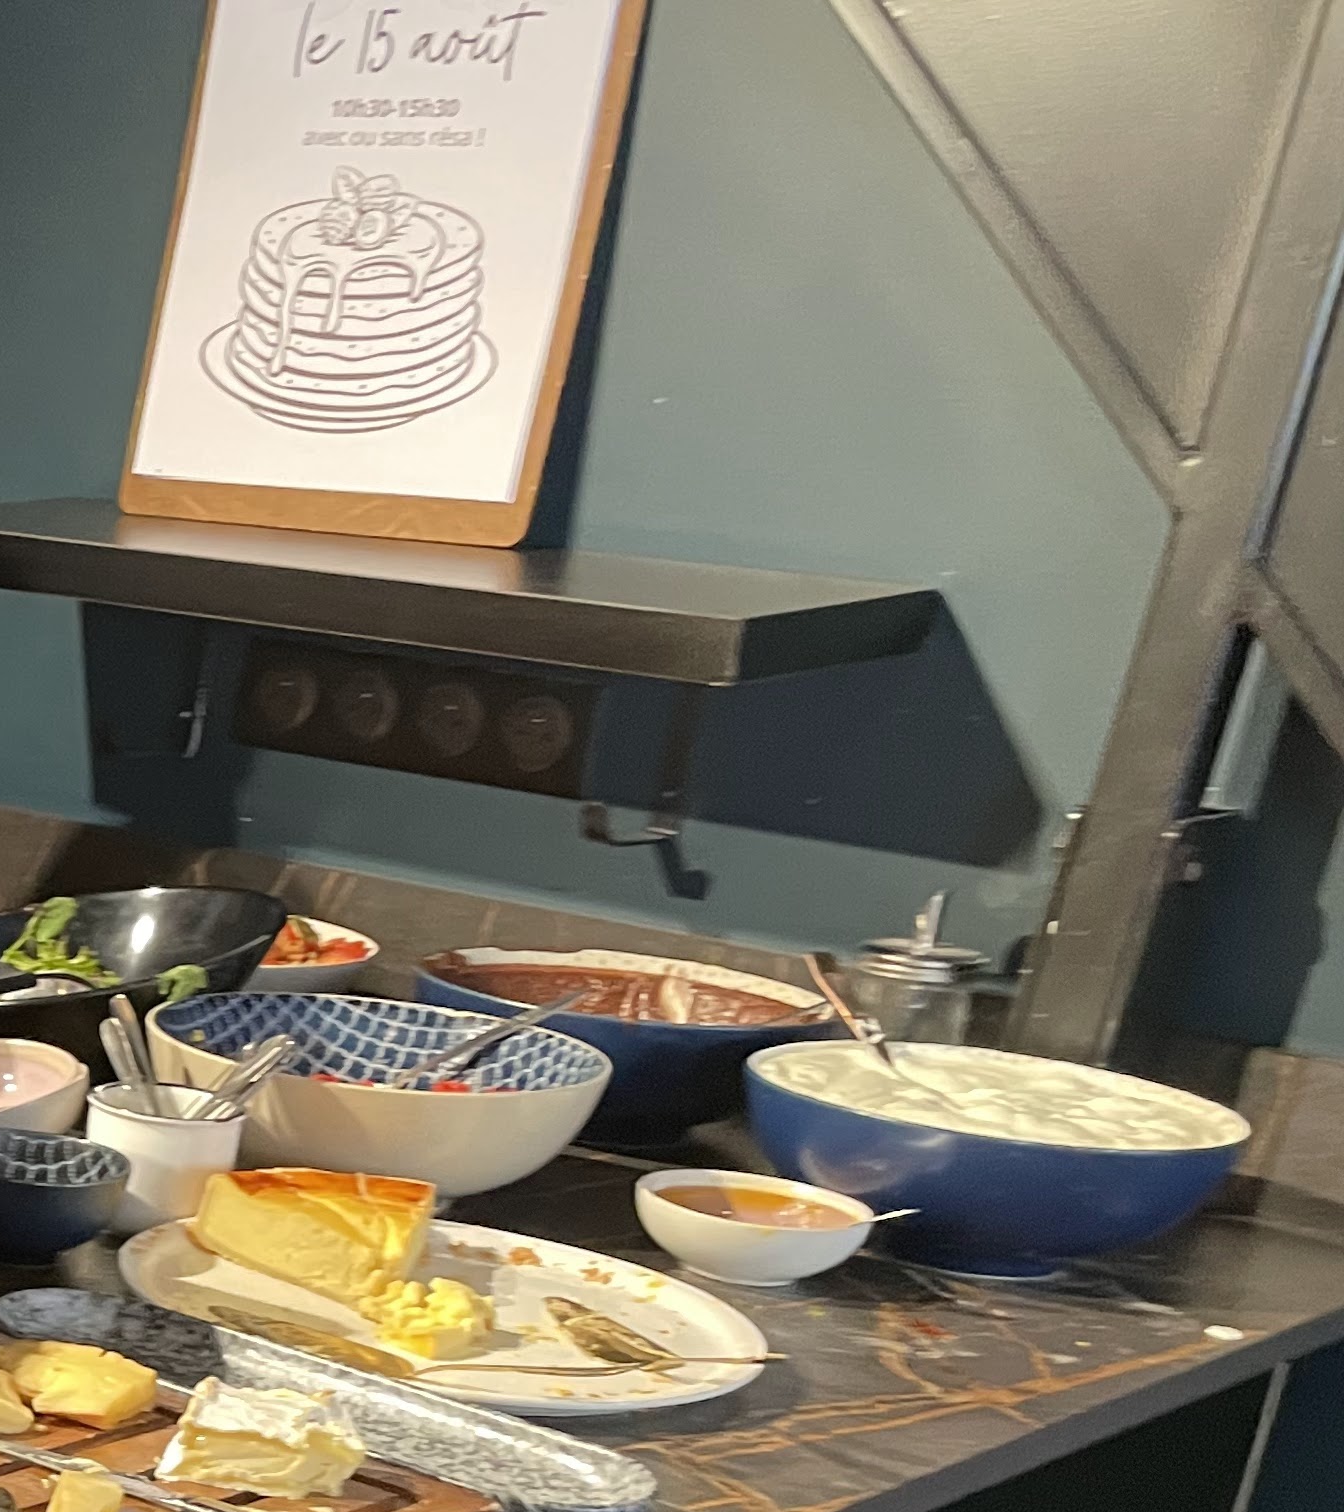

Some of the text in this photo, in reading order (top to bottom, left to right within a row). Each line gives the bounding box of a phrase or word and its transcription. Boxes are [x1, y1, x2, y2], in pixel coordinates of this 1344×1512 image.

[293, 1, 548, 82] le 15 août
[302, 130, 347, 147] avec
[349, 131, 376, 147] ou
[379, 131, 426, 147] sans
